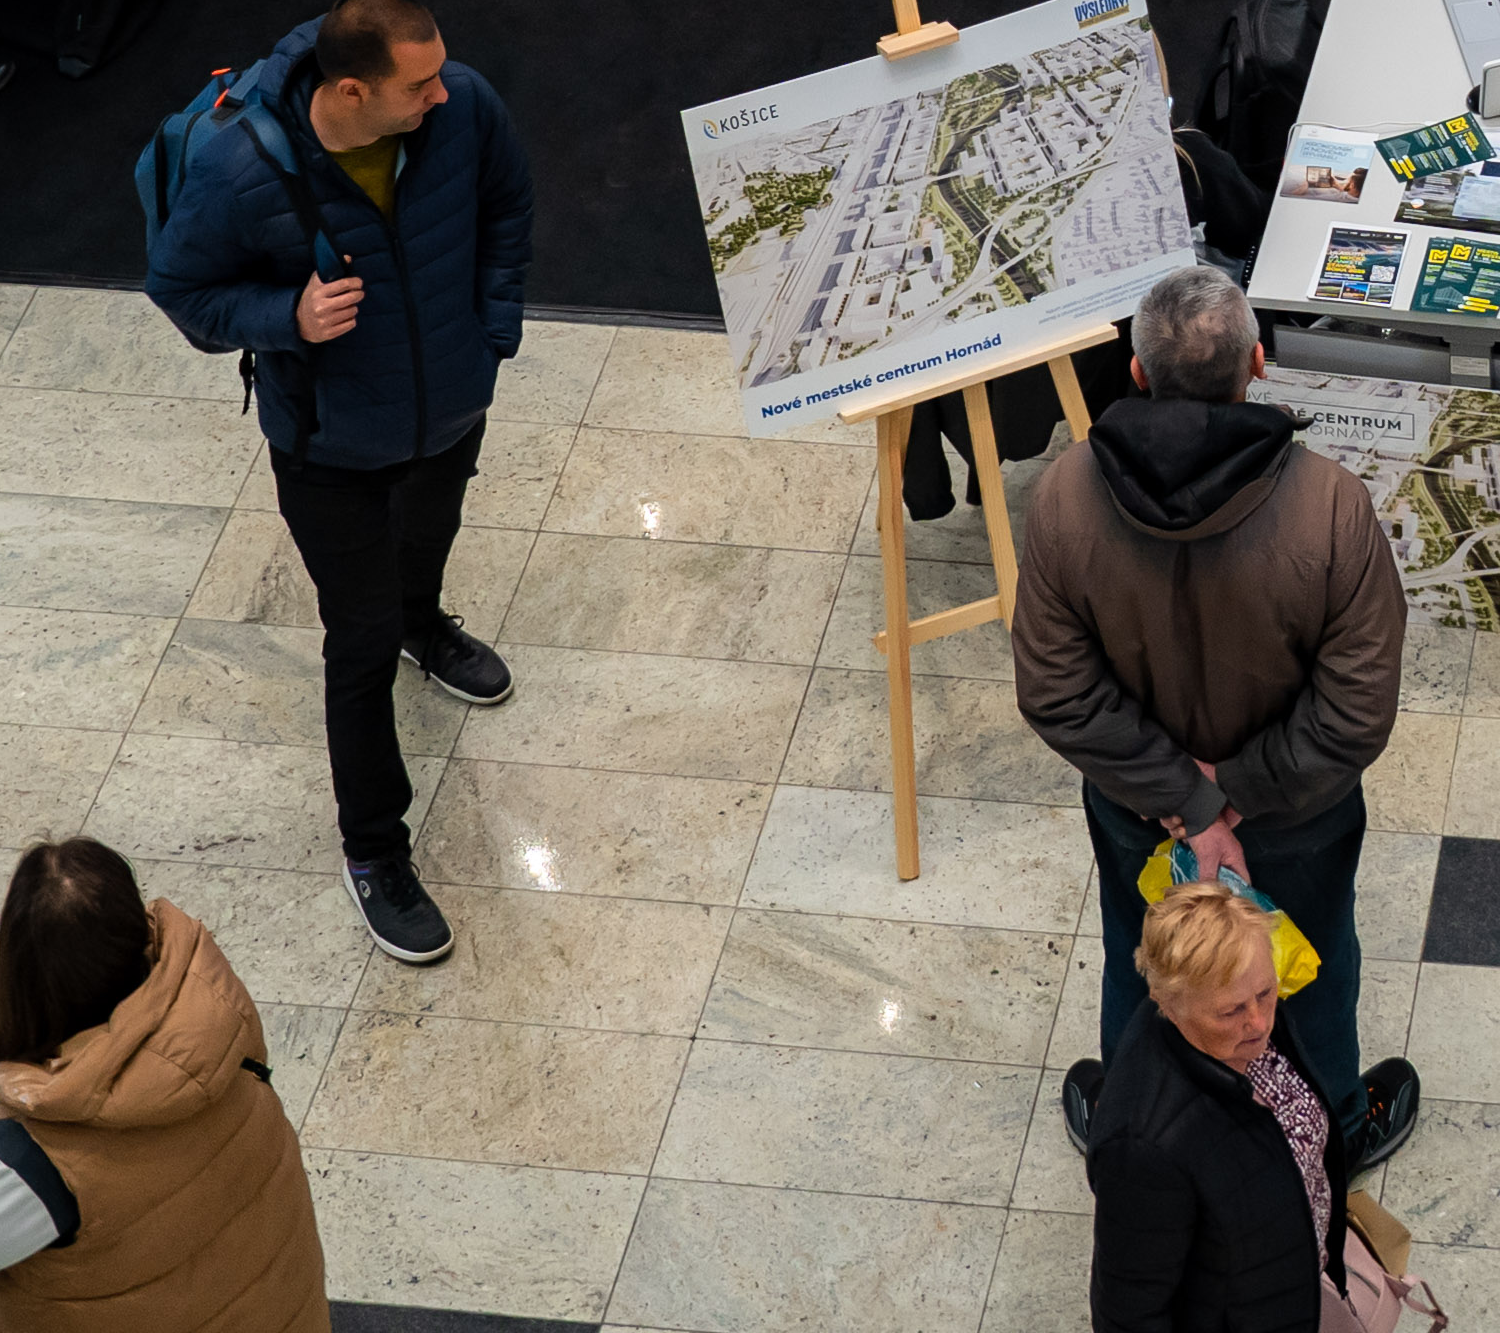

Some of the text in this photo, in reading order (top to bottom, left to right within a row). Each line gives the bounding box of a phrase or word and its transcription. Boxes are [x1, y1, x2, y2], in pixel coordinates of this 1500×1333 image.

[719, 103, 780, 133] KOŠICE
[761, 333, 1003, 420] Nové mestské centrum Hornád
[1312, 411, 1402, 431] CENTRUM
